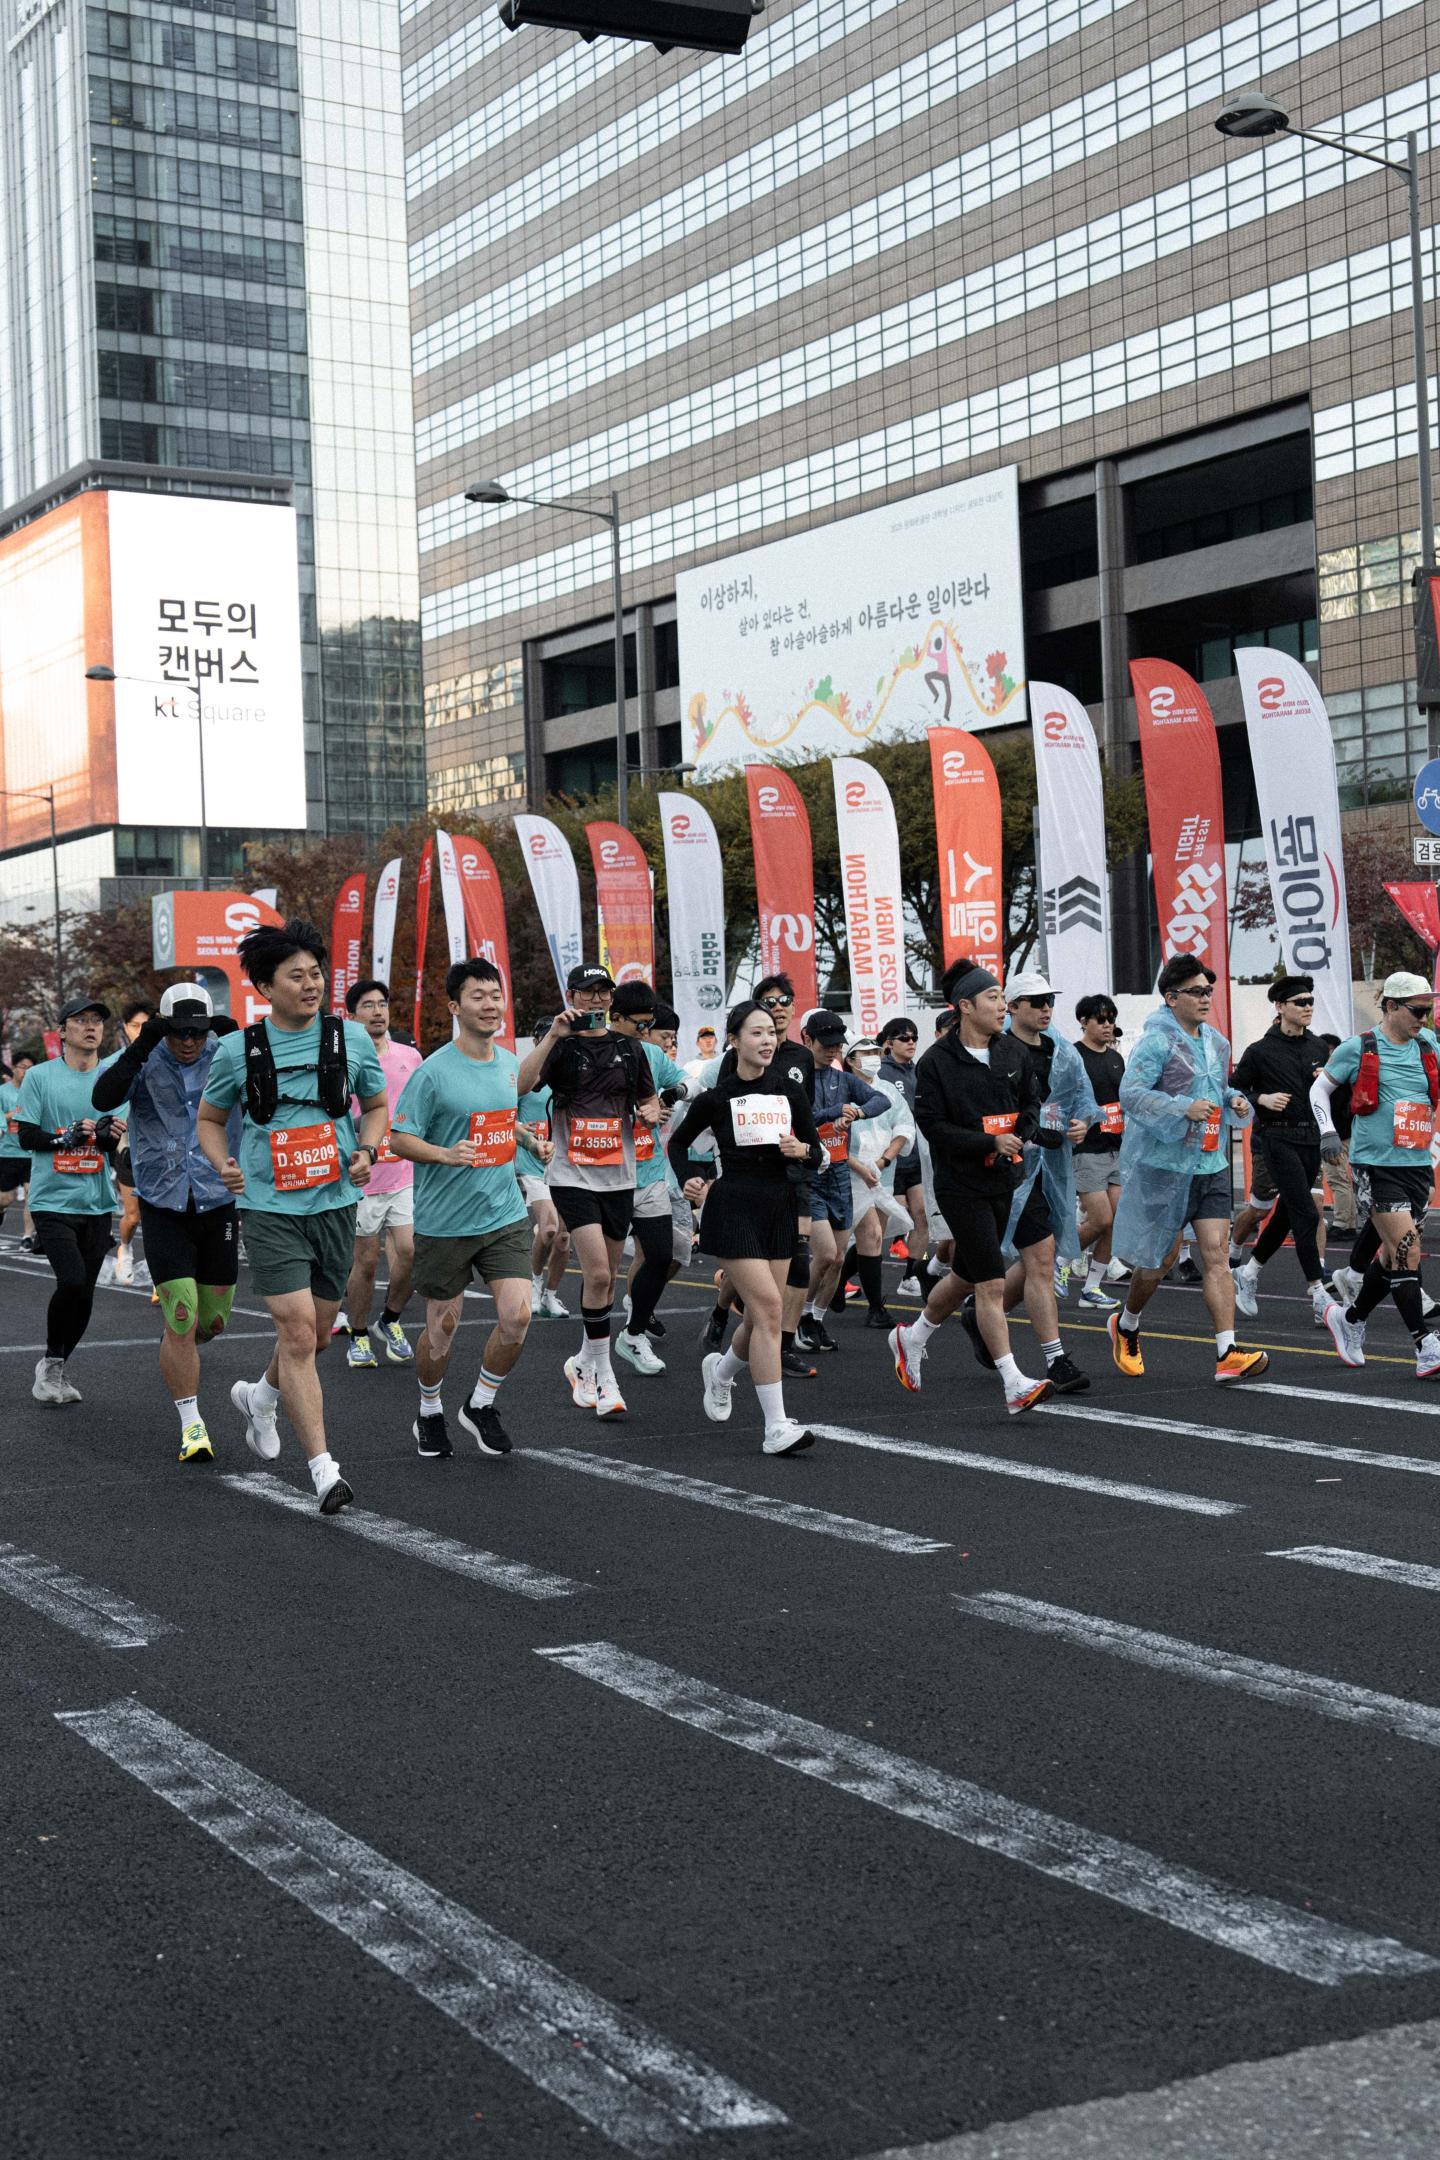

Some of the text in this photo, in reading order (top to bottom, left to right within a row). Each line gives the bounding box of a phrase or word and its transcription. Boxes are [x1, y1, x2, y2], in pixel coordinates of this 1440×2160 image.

[701, 574, 758, 611] 이상하지,
[158, 599, 257, 639] 모두의
[738, 613, 759, 636] 살아
[763, 606, 794, 631] 있다는
[770, 572, 990, 657] 참 아슬아슬하게 아름다운 일이란다
[159, 646, 260, 684] 캔버스
[154, 696, 266, 725] kt Square
[346, 940, 360, 987] ATHON
[584, 968, 608, 978] HOKA
[334, 968, 345, 1003] MBN
[737, 1112, 788, 1126] D.36976
[474, 1129, 514, 1146] D.36314
[573, 1136, 619, 1149] D.35531
[277, 1144, 336, 1168] D.36209
